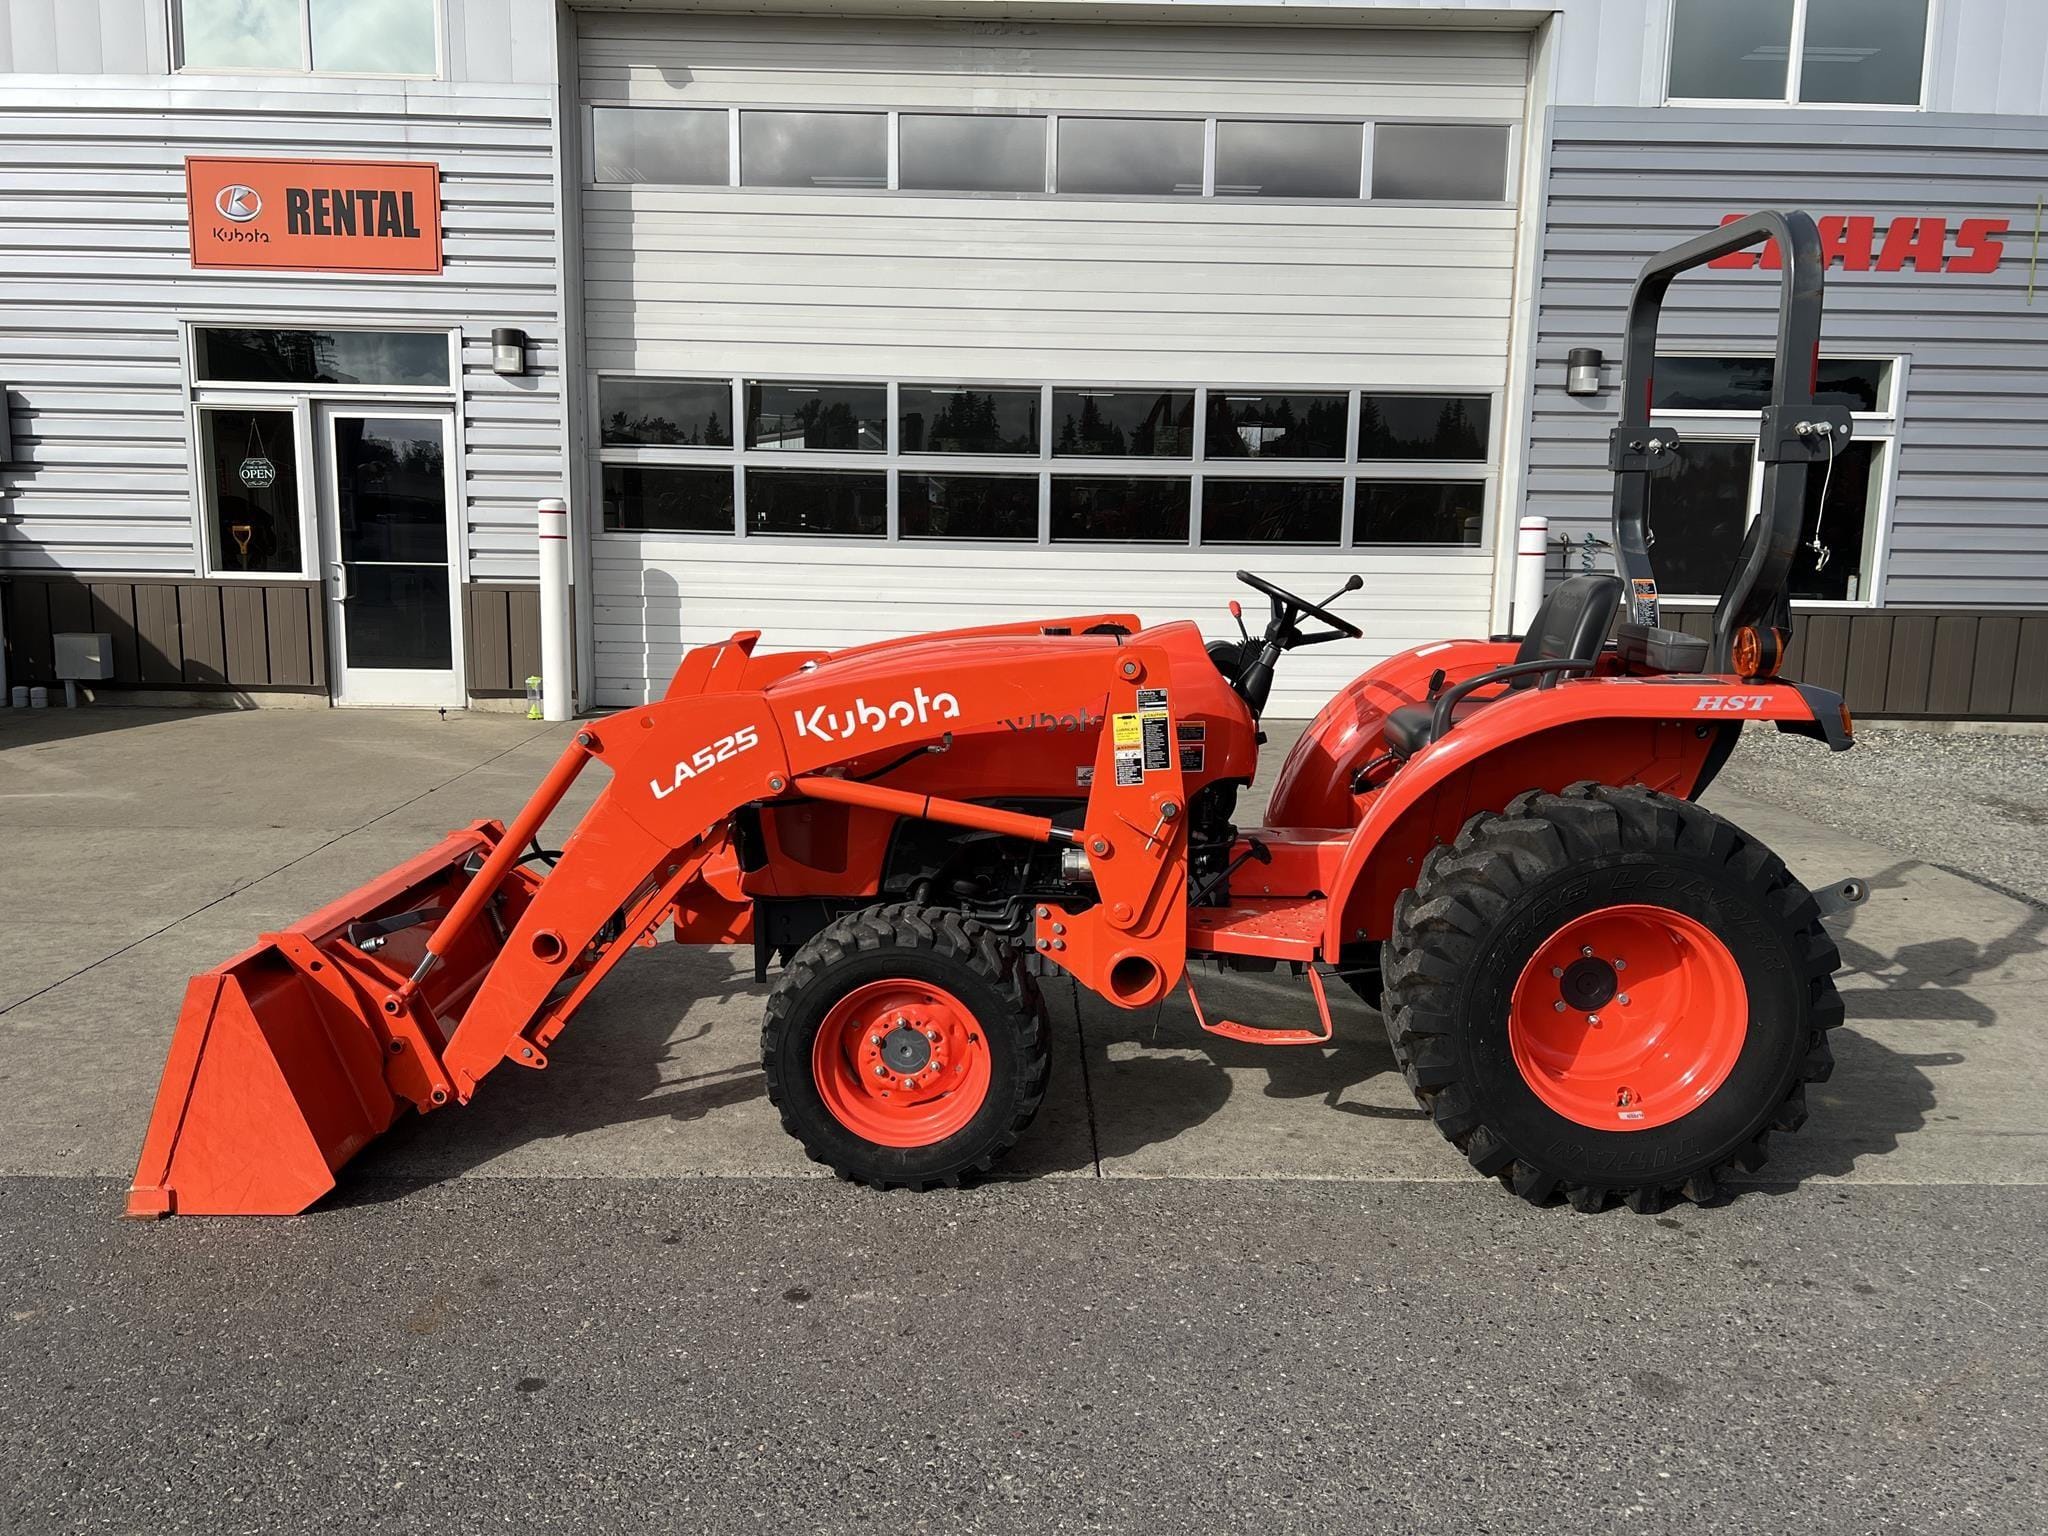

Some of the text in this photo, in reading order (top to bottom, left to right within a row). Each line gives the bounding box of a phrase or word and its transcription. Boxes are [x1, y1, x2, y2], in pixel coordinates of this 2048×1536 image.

[286, 188, 421, 238] RENTAL
[213, 227, 270, 243] Kubota
[241, 469, 272, 479] OPEN
[795, 687, 961, 742] Kubota
[1692, 695, 1773, 711] HST
[650, 725, 759, 799] LA525
